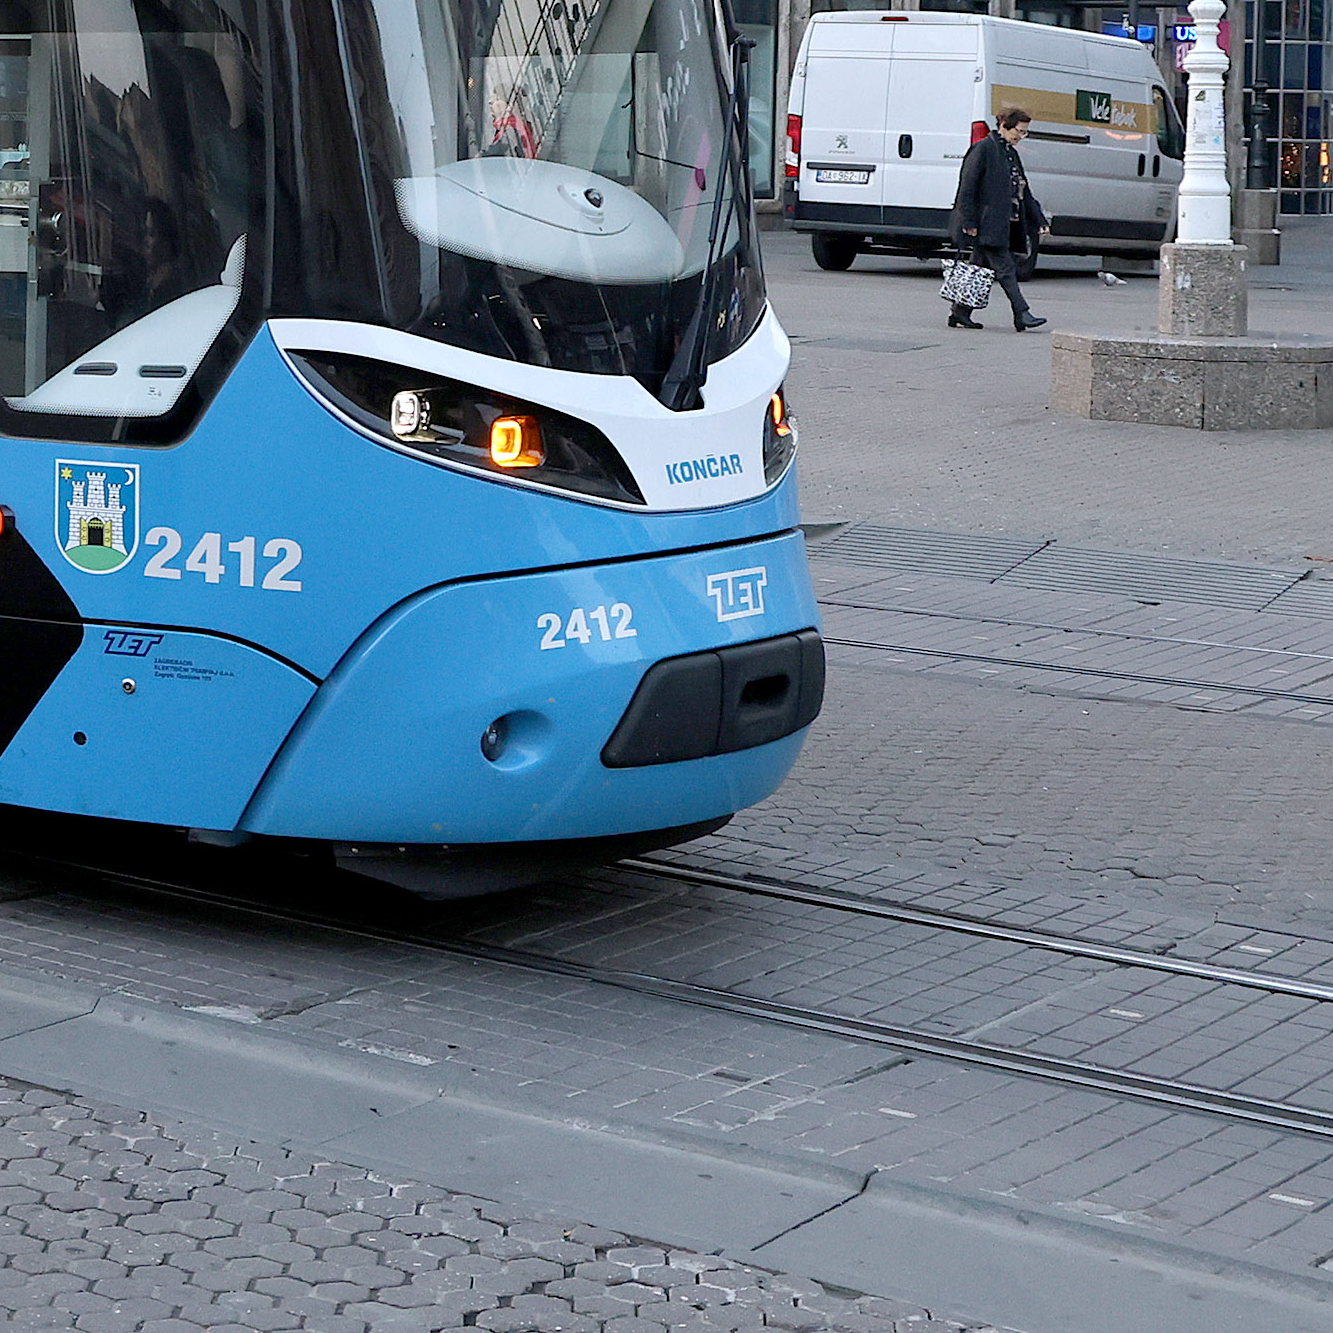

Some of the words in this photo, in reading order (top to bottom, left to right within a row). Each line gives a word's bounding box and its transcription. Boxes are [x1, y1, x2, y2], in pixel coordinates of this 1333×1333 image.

[665, 454, 745, 485] KONČAR
[143, 526, 303, 593] 2412
[536, 602, 638, 651] 2412
[706, 566, 769, 624] ZET
[103, 630, 165, 658] ZET
